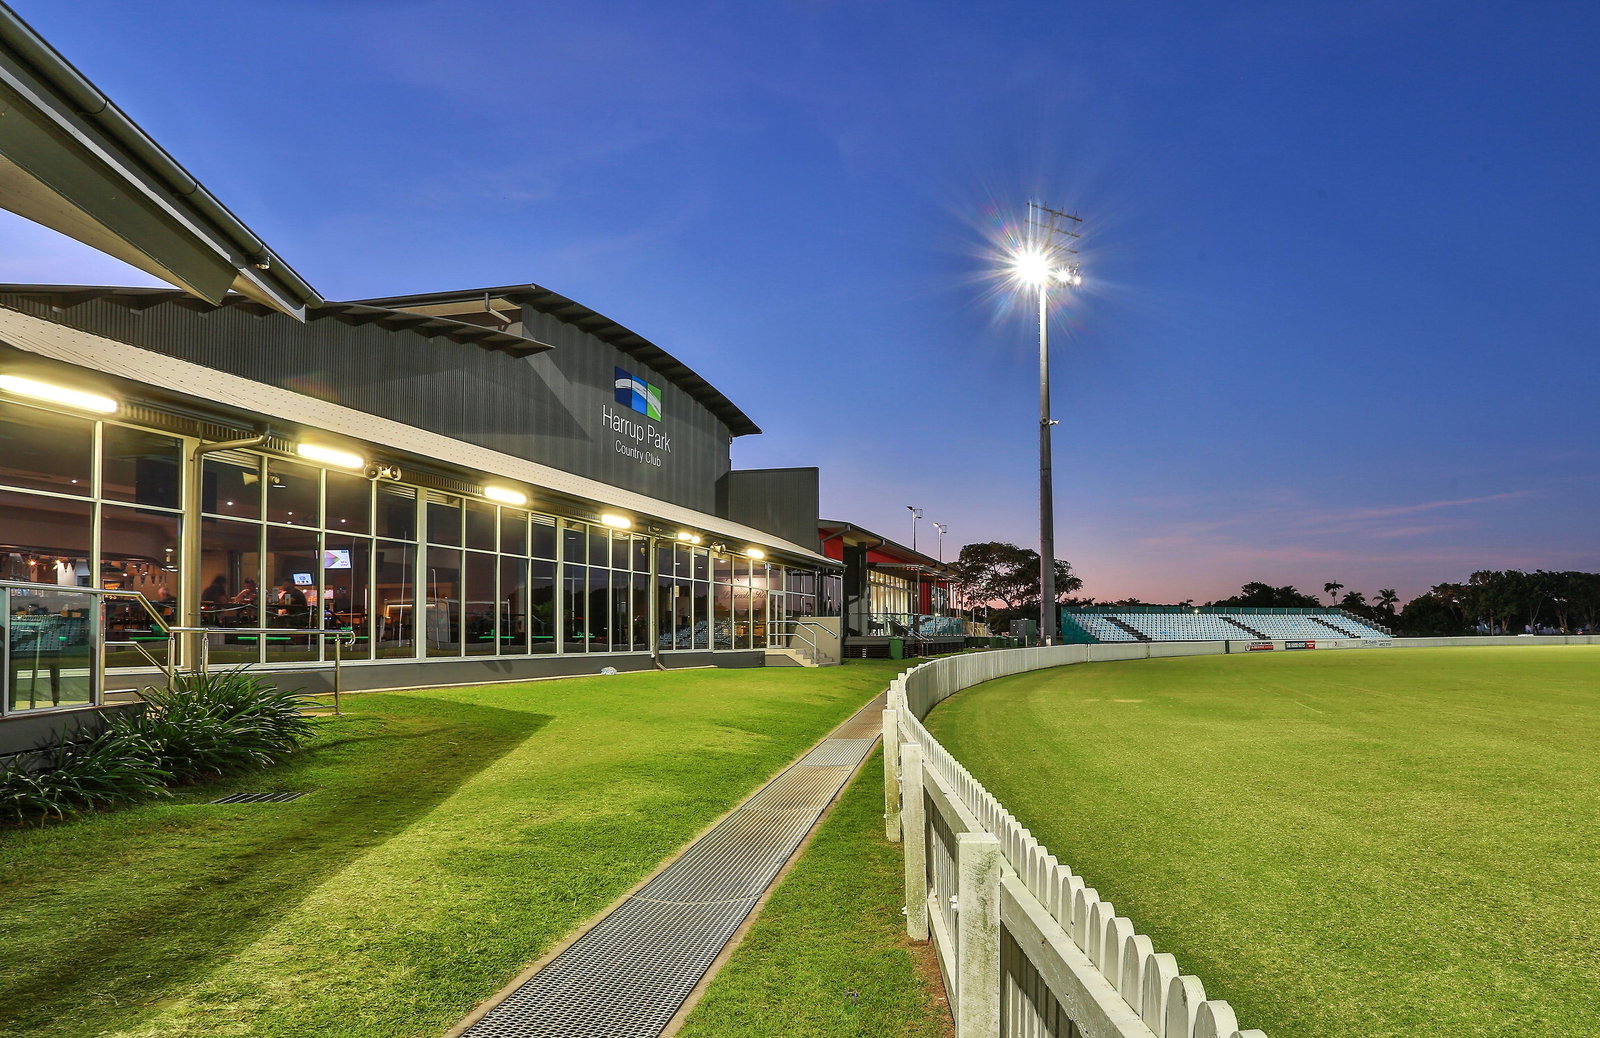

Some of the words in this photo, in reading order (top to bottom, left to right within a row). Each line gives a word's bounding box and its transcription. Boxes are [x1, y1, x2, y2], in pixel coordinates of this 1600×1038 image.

[602, 404, 644, 445] Harrup
[647, 424, 671, 453] Park
[615, 439, 644, 463] Country
[645, 451, 661, 467] Club
